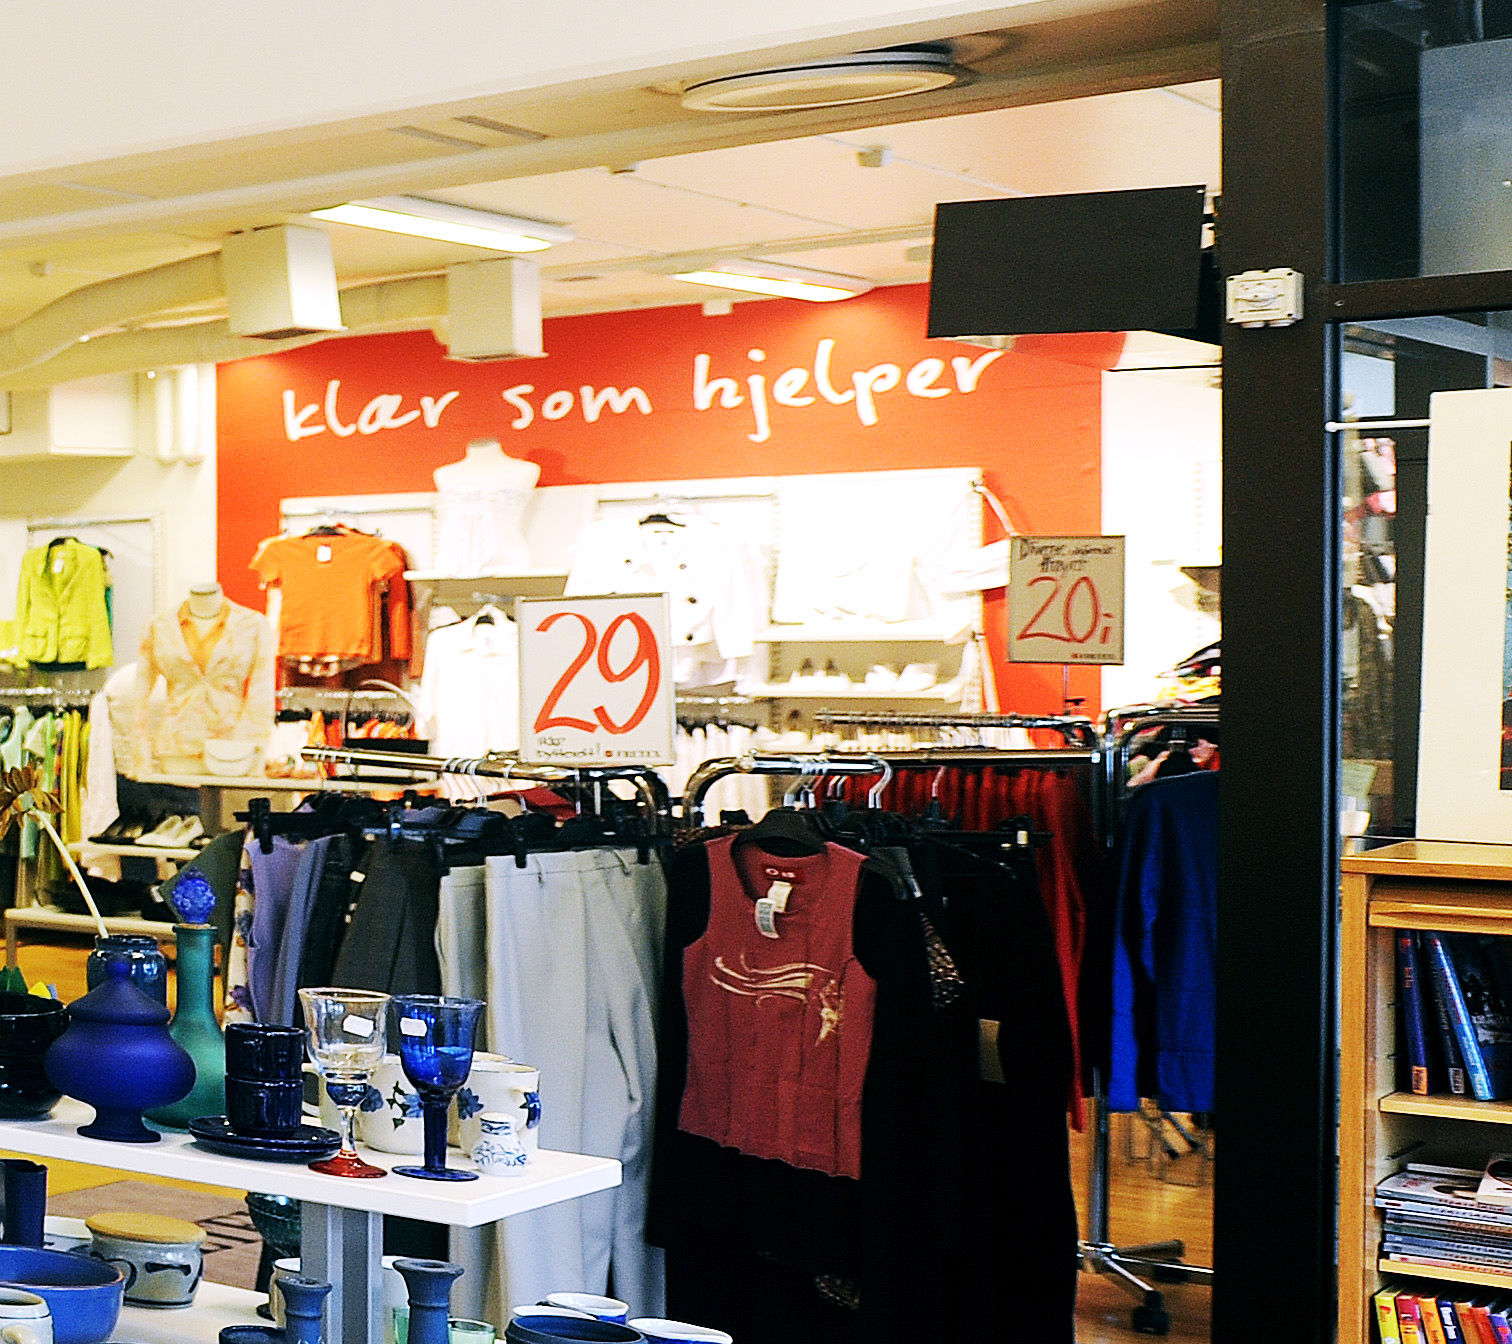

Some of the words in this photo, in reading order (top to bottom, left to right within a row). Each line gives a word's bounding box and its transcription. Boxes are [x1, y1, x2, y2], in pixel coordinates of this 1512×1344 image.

[282, 379, 460, 442] klær
[502, 384, 653, 431] som
[692, 338, 1005, 443] hjelper
[533, 611, 661, 735] 29
